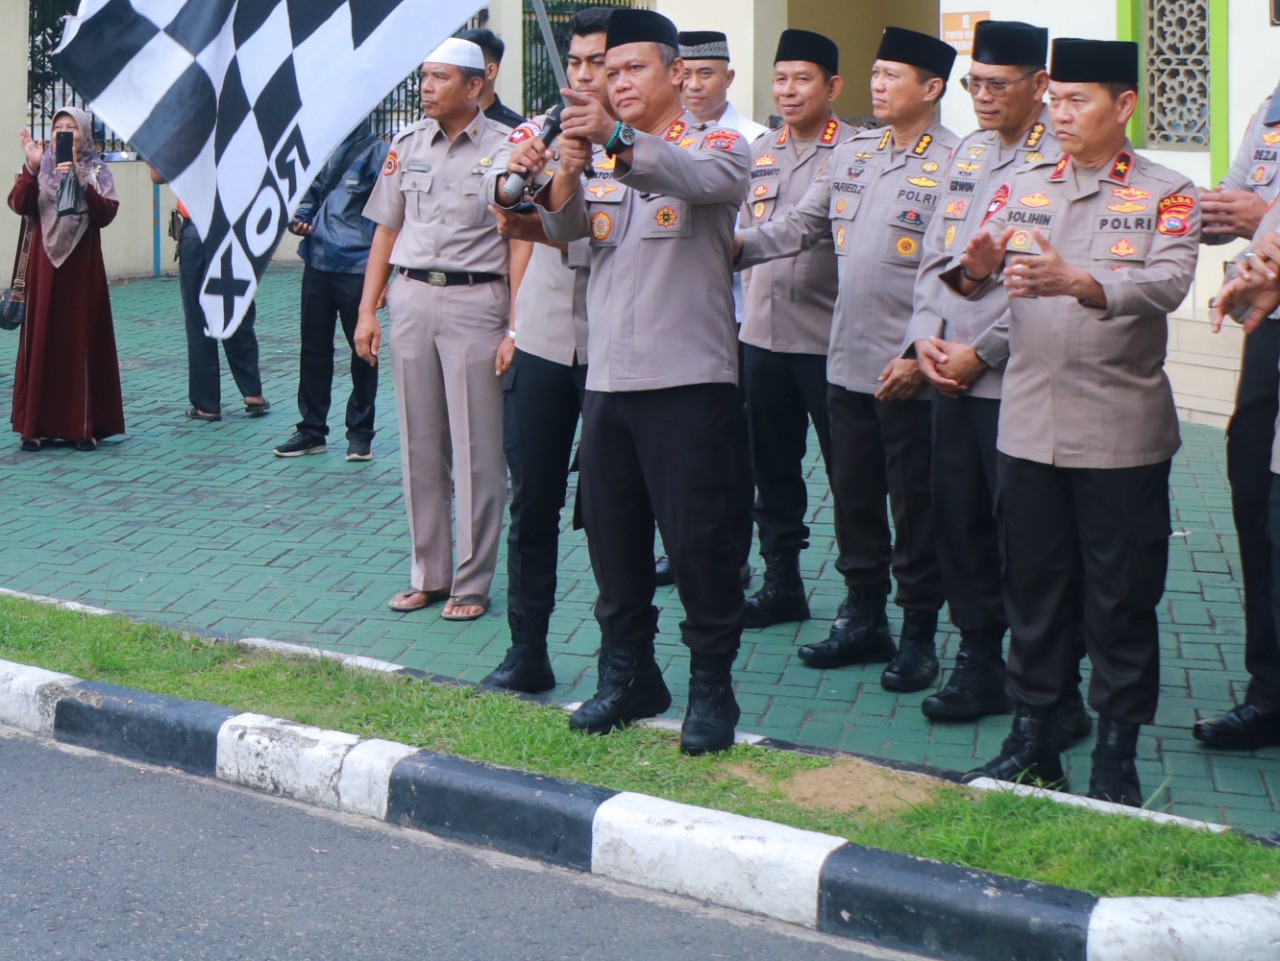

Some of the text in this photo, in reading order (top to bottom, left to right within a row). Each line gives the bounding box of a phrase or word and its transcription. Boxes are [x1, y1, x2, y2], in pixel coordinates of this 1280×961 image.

[949, 180, 976, 193] ERWIN
[897, 190, 937, 206] POLRI
[1159, 196, 1191, 209] POLDA
[1007, 211, 1052, 226] SOLIHIN
[1099, 218, 1151, 231] POLRI
